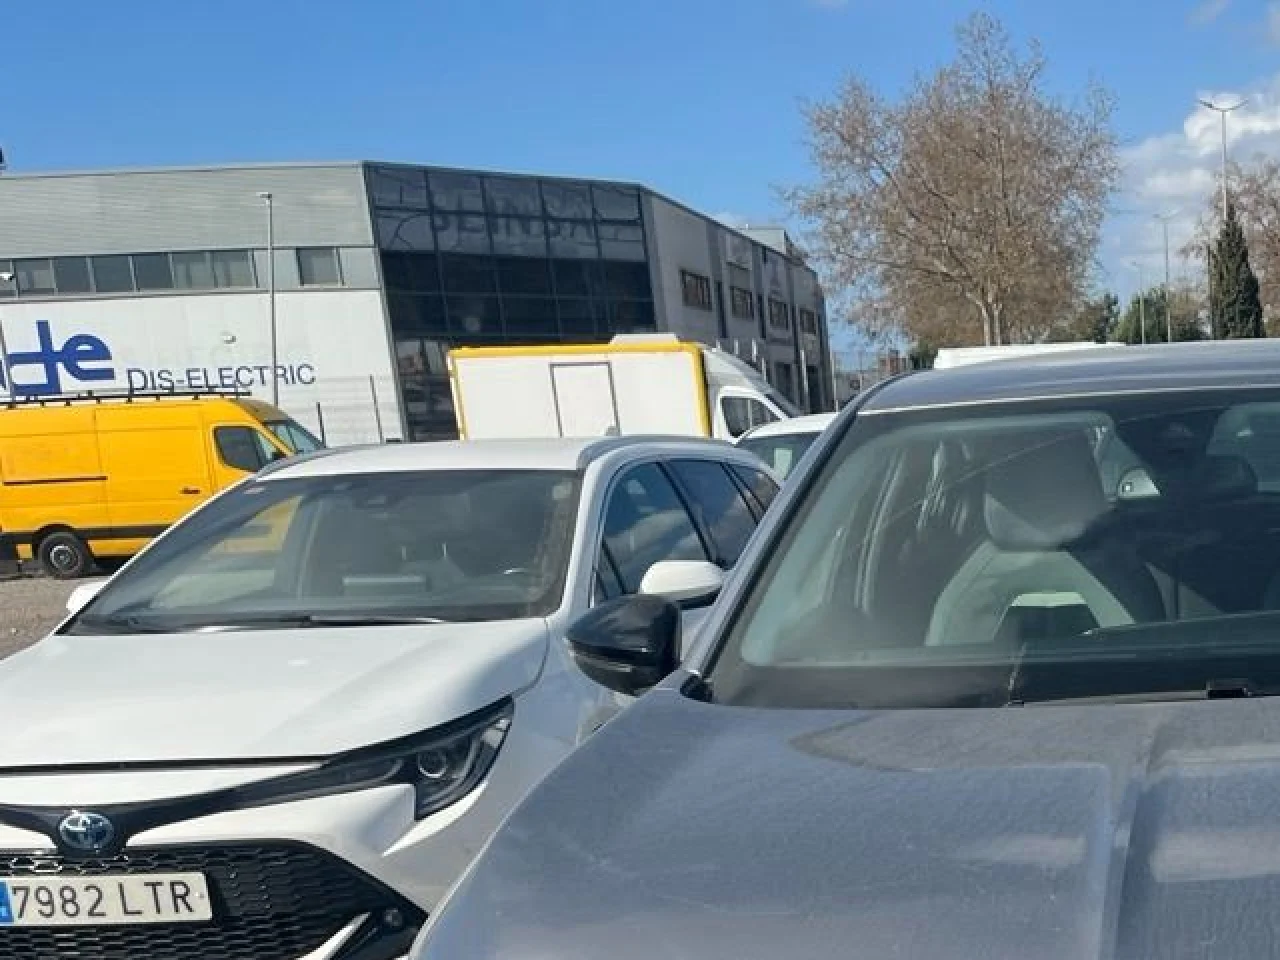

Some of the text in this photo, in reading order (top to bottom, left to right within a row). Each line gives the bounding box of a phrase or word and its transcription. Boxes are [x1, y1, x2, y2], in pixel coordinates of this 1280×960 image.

[0, 320, 114, 396] de
[127, 363, 317, 391] DIS-ELECTRIC
[12, 880, 195, 919] 7982 LTR
